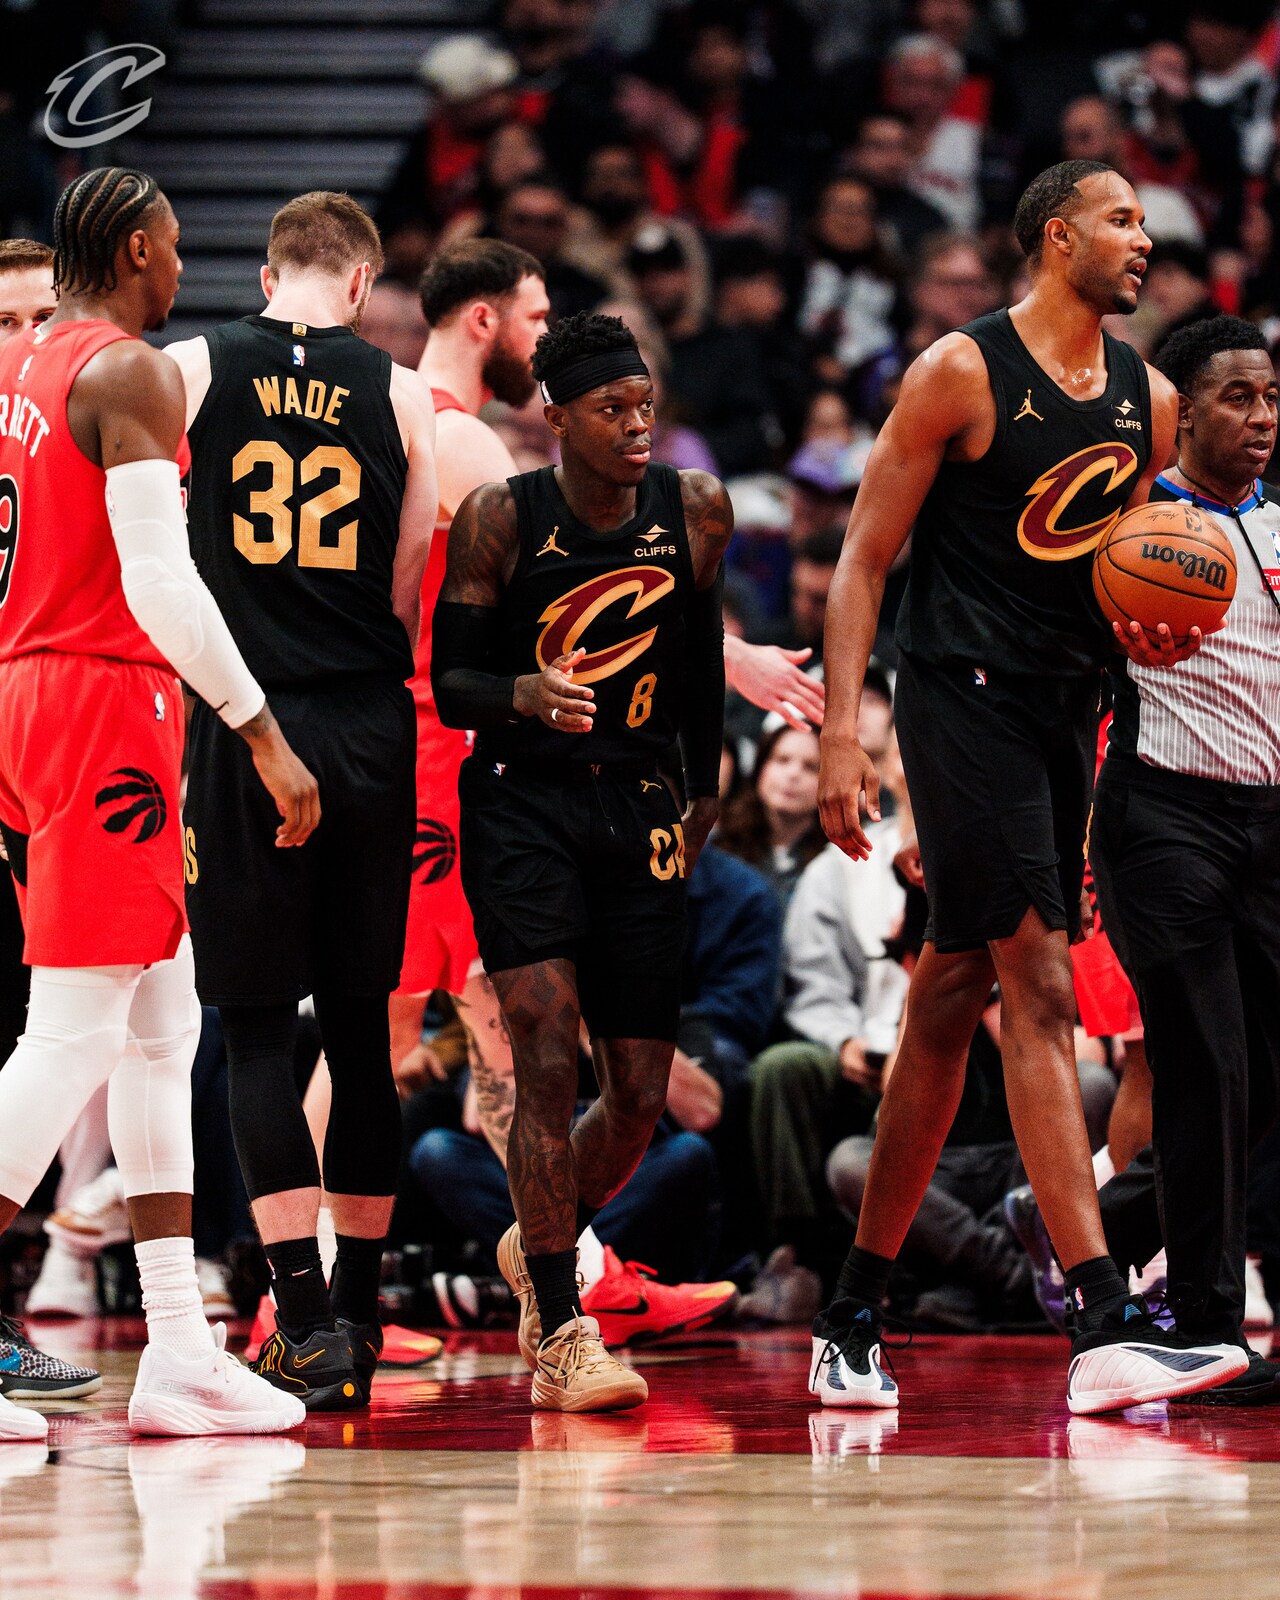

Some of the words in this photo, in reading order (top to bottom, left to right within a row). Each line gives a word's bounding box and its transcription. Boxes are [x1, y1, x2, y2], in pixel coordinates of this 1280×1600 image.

[252, 375, 351, 426] WADE
[1114, 418, 1142, 432] CLIFFS
[231, 440, 362, 571] 32
[634, 545, 677, 558] CLIFFS
[1140, 541, 1228, 592] Wilson
[625, 672, 658, 729] 8
